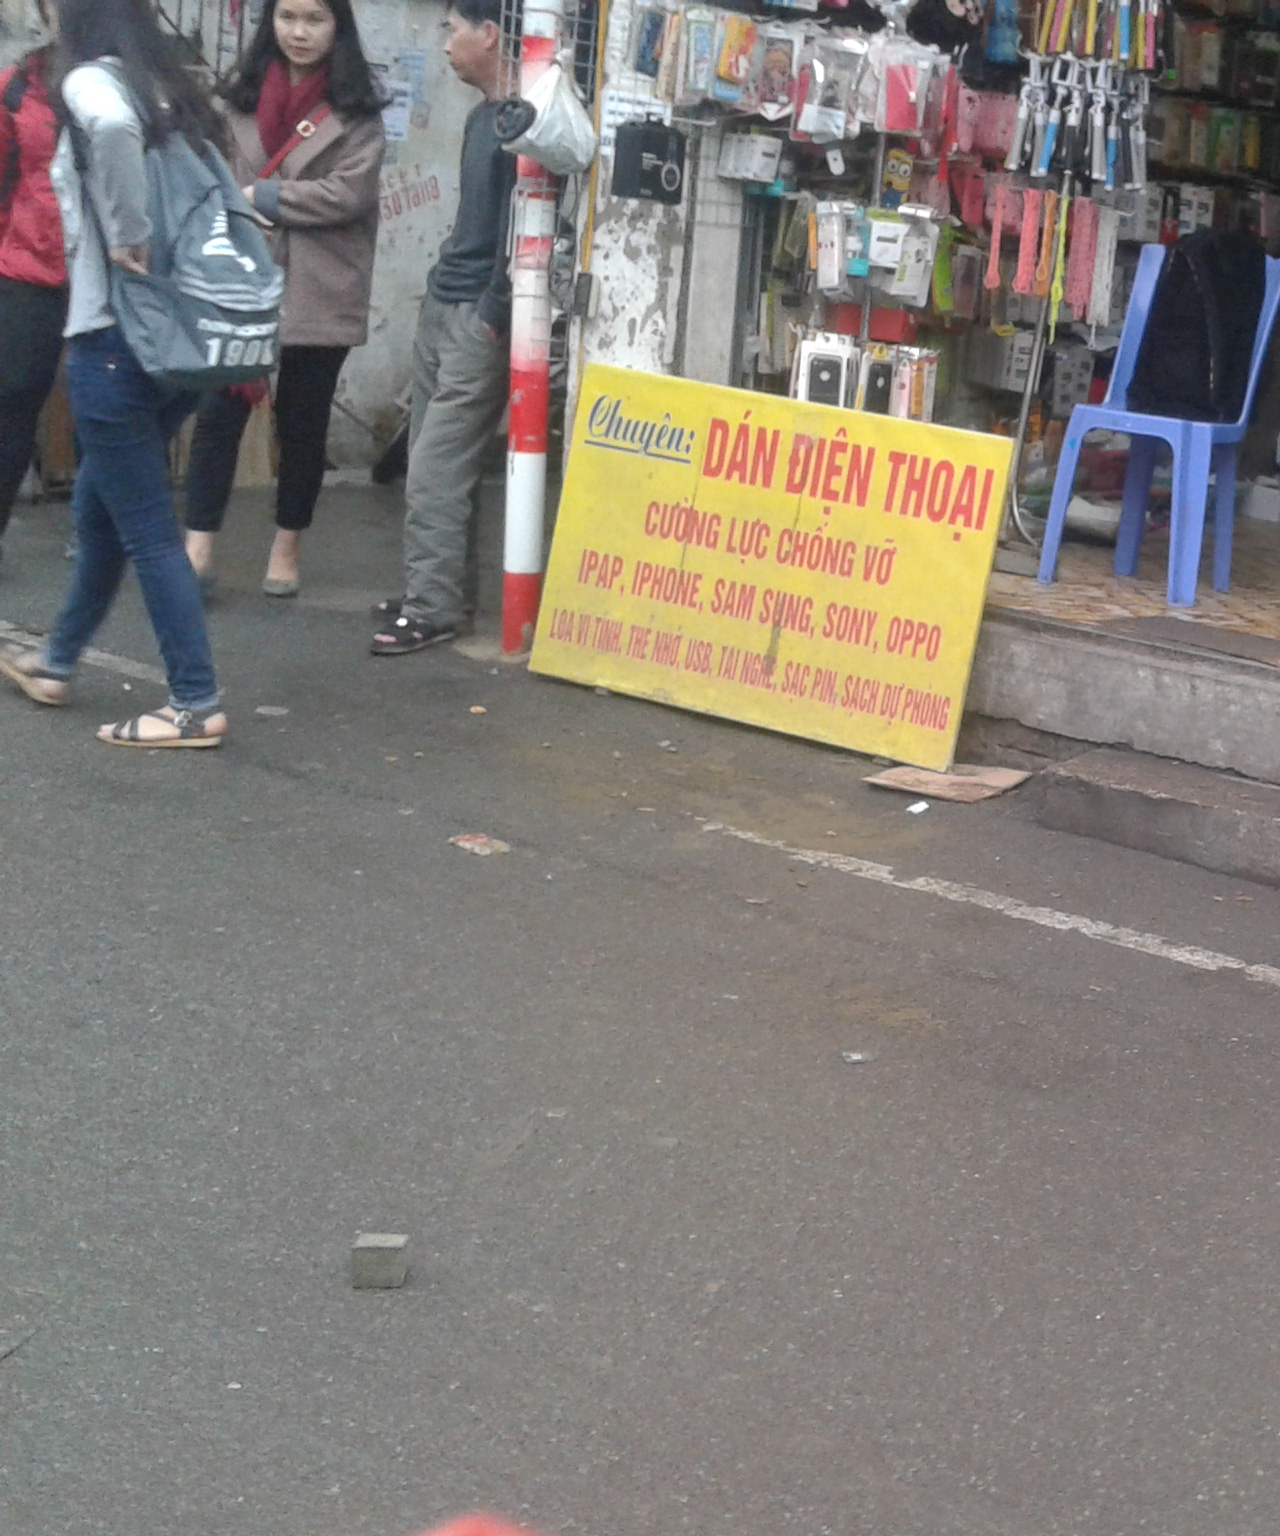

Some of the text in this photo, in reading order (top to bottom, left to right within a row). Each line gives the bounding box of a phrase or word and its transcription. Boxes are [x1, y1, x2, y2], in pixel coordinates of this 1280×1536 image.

[587, 394, 995, 542] Chuyên: DÁN ĐIỆN THOẠI
[644, 496, 898, 586] CƯỜNG LỰC CHỐNG VỠ
[630, 560, 704, 614] IPHONE,
[710, 577, 757, 622] SAM
[758, 588, 815, 639] SUNG,
[822, 601, 879, 654] SONY,
[885, 615, 942, 662] OPPO
[549, 608, 576, 644] LOA
[576, 613, 592, 647] VI
[684, 638, 713, 677] USB,
[717, 645, 741, 681] TAI
[781, 660, 811, 703] SẠC
[840, 674, 881, 717] SẠCH
[879, 682, 906, 726] DỰ
